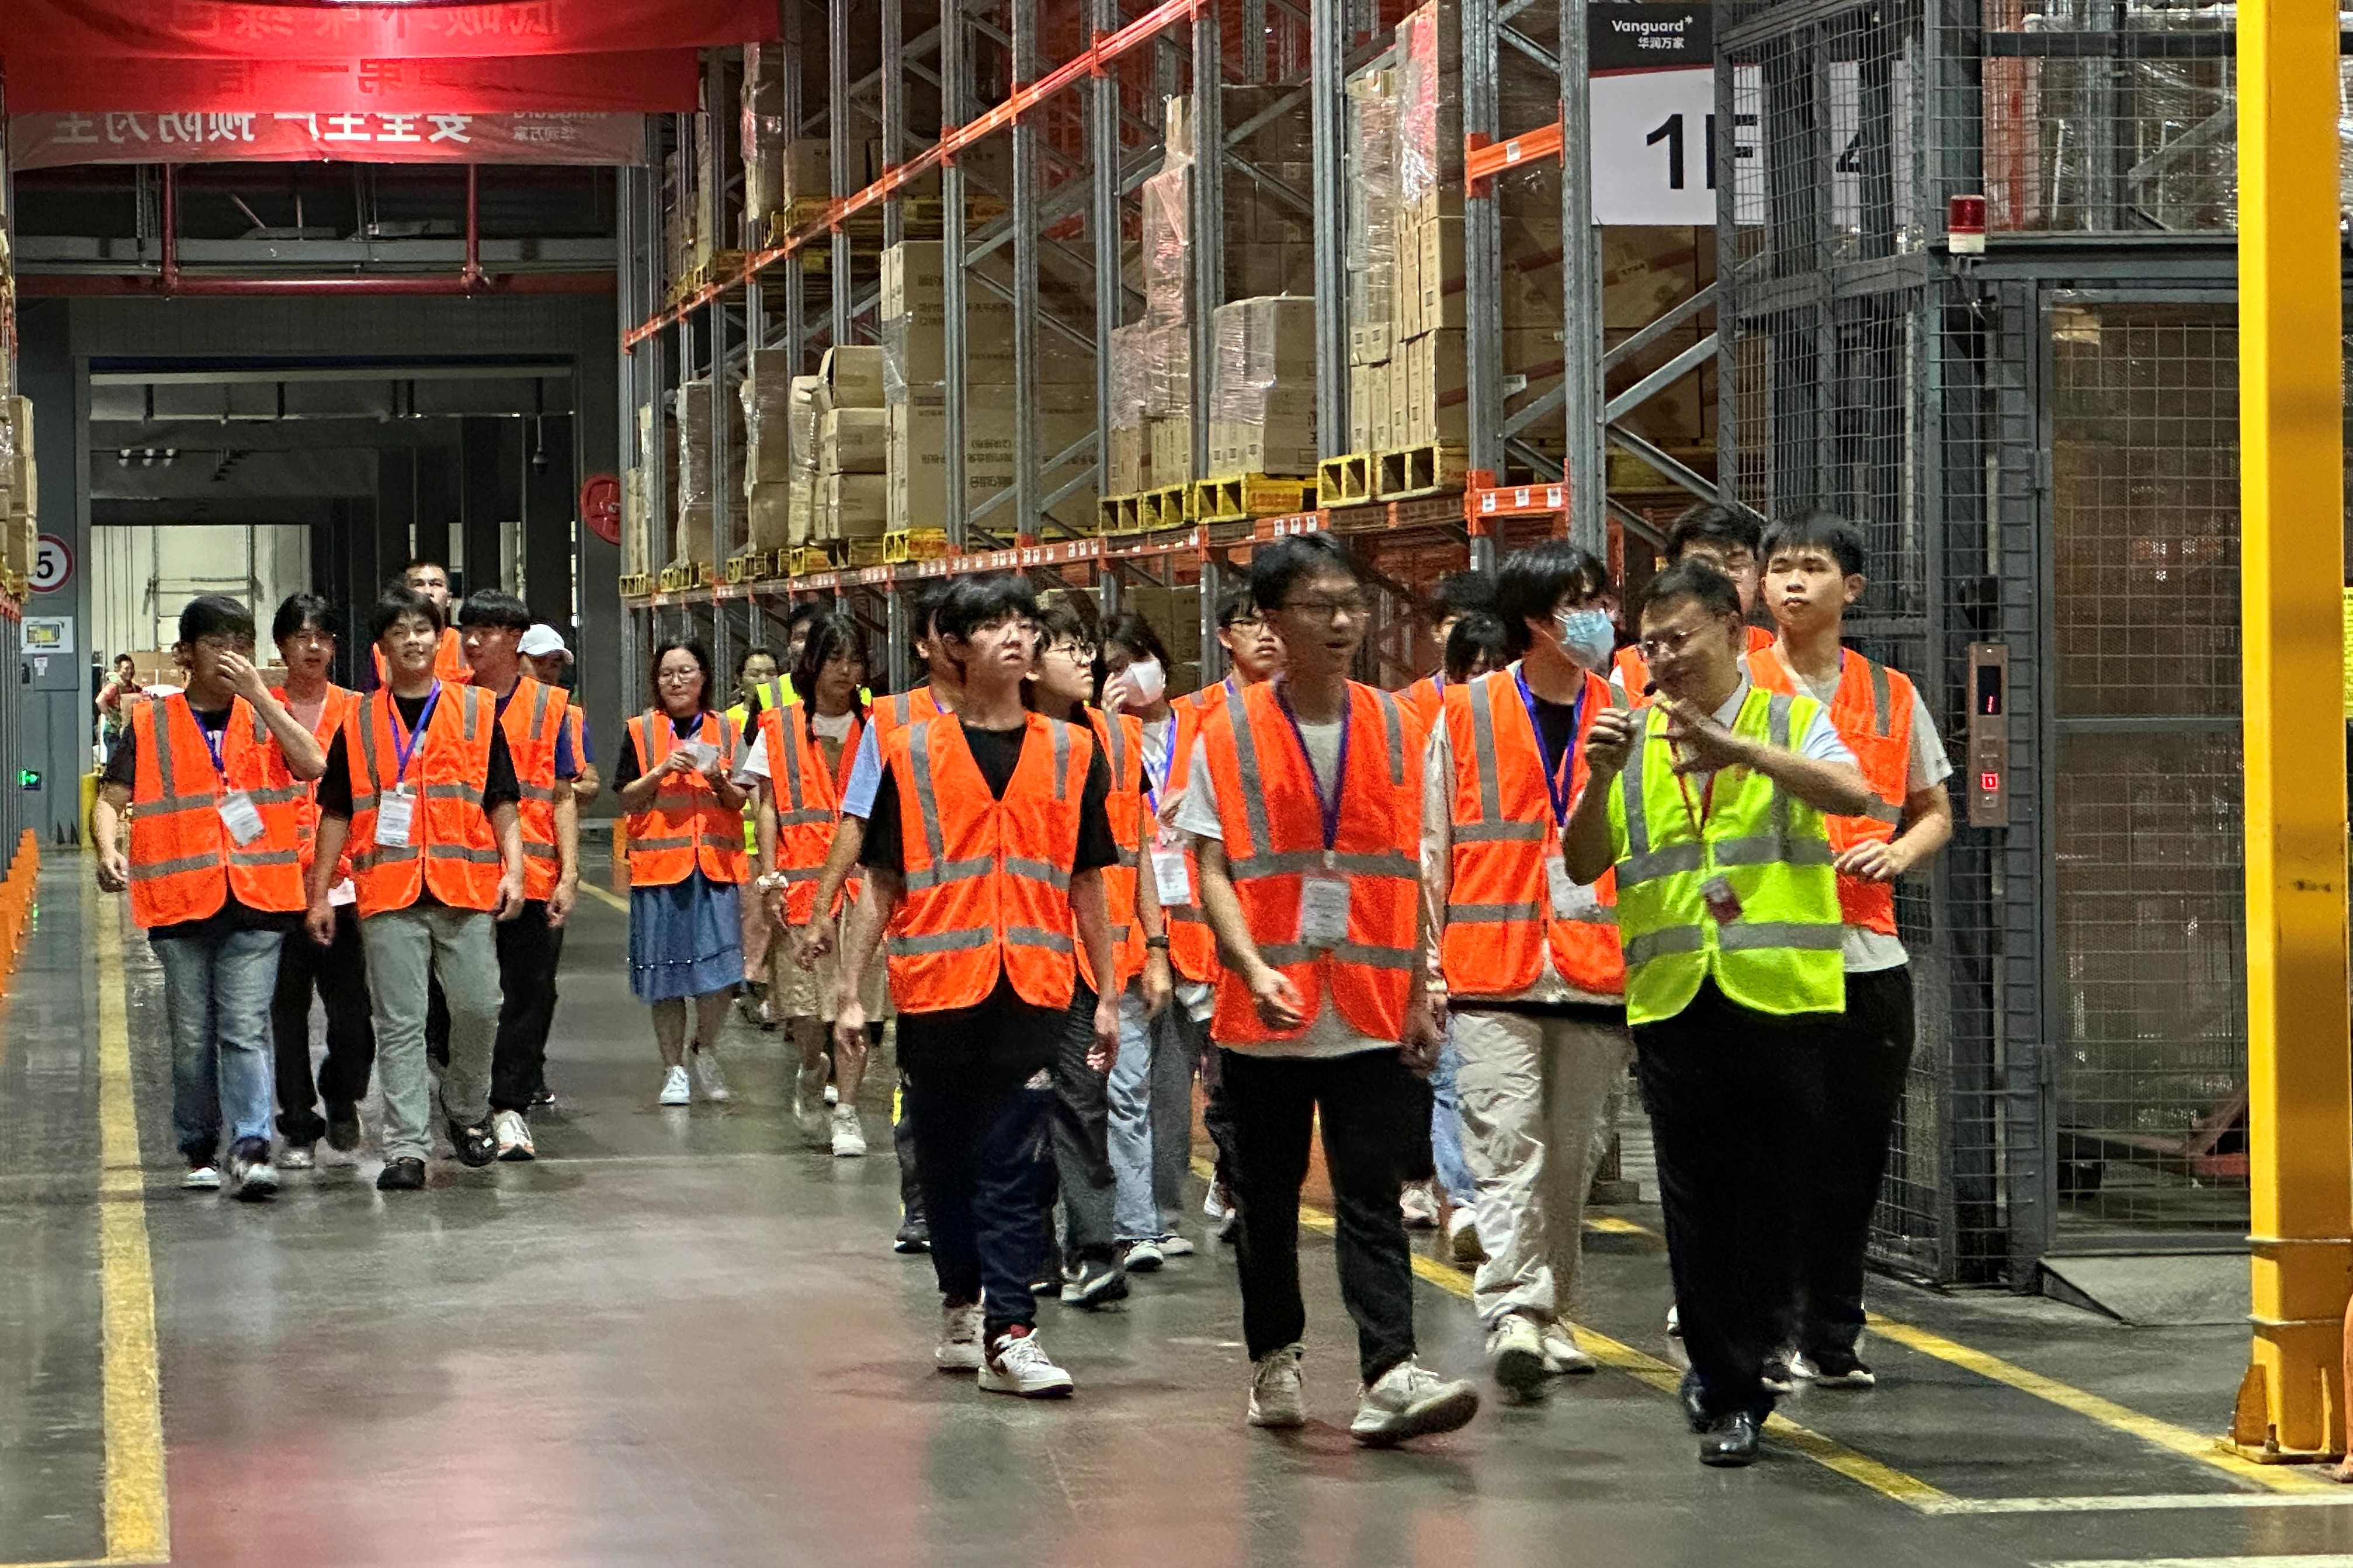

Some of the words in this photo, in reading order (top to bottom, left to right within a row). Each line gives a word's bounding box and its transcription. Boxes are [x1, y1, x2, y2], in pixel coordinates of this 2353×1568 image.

[1611, 19, 1684, 36] Vanguard
[1637, 36, 1685, 49] 华润万家
[37, 551, 54, 579] 5
